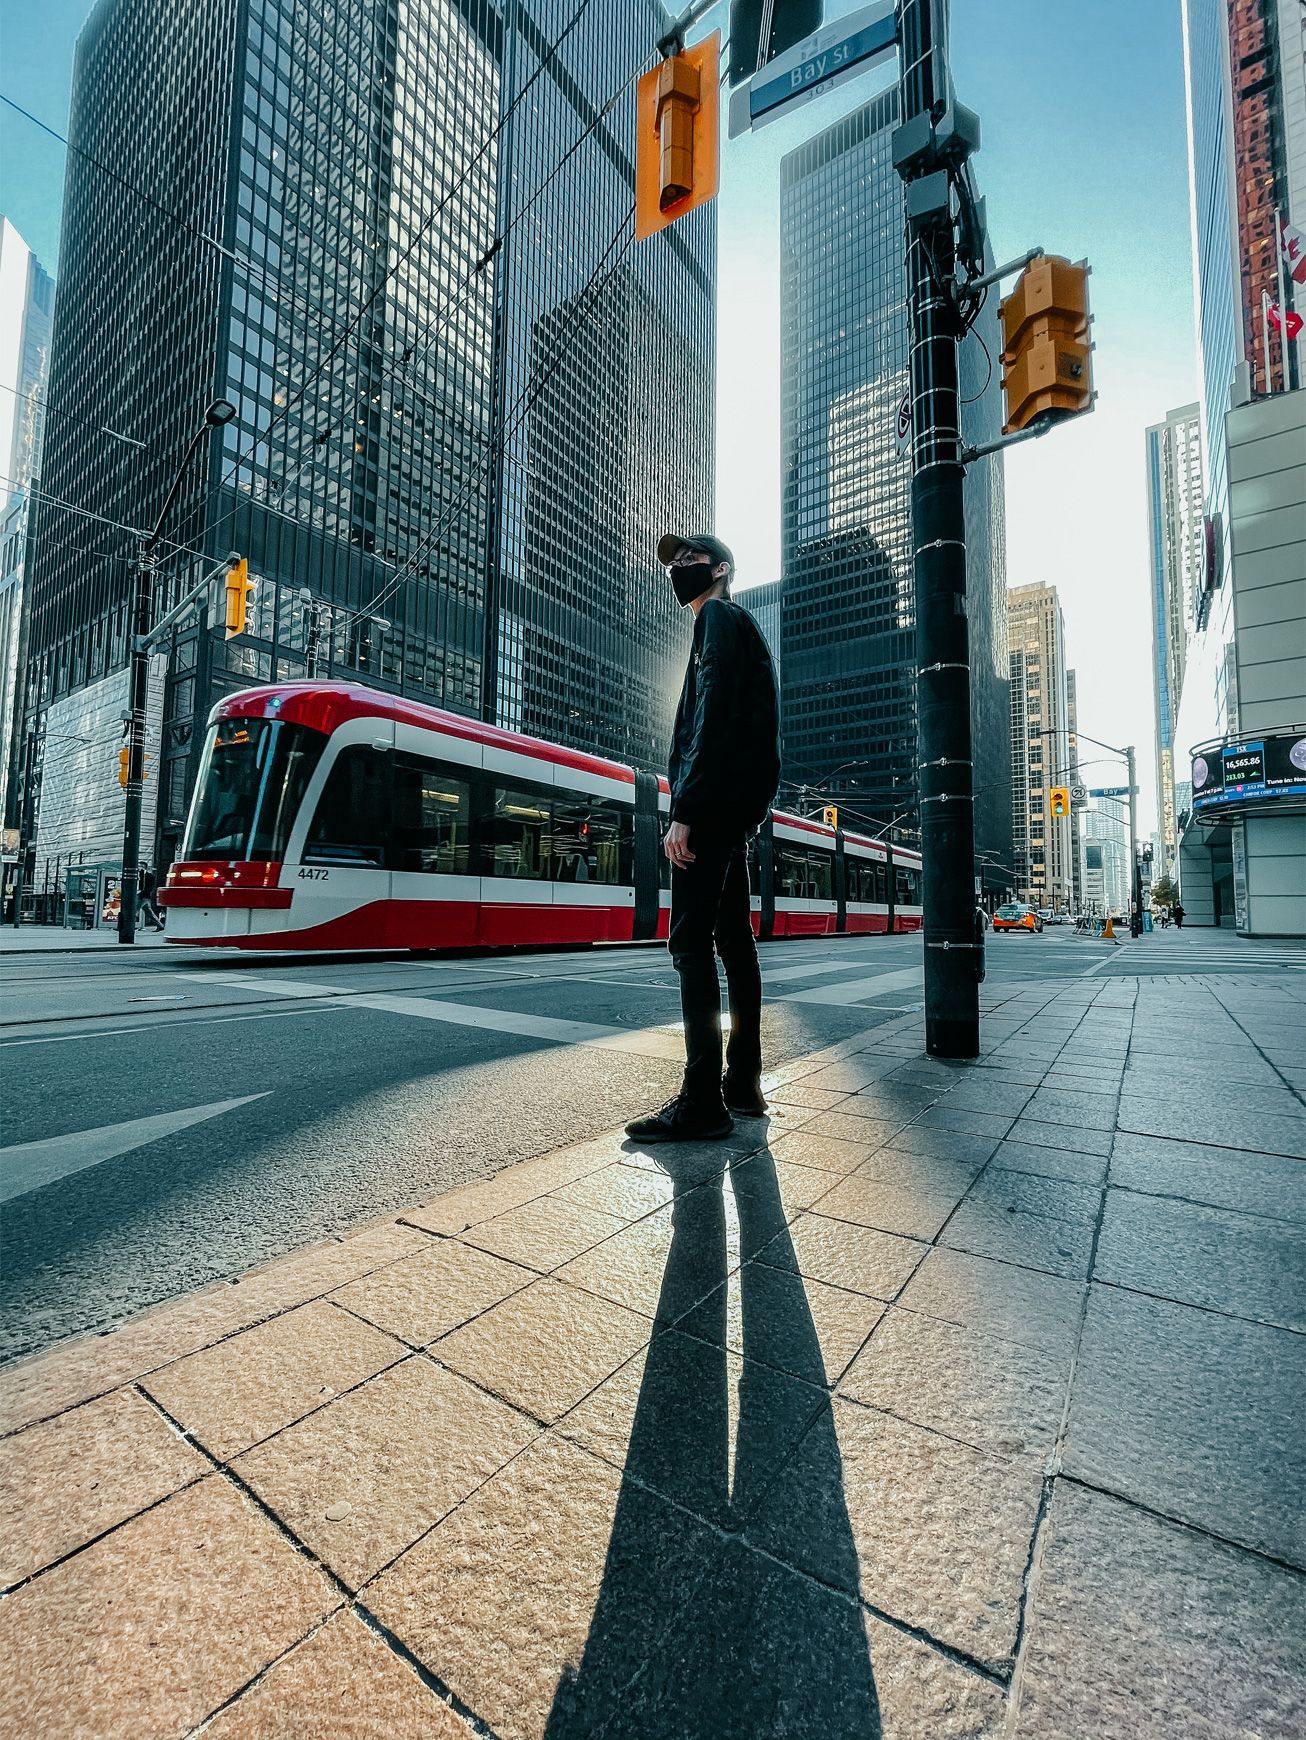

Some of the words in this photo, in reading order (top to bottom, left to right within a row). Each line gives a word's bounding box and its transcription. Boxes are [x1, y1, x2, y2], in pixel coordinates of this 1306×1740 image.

[791, 55, 827, 88] Bay
[833, 43, 848, 64] St
[1226, 757, 1260, 769] 16,565.86
[1103, 788, 1118, 796] Bay
[297, 868, 329, 881] 4472
